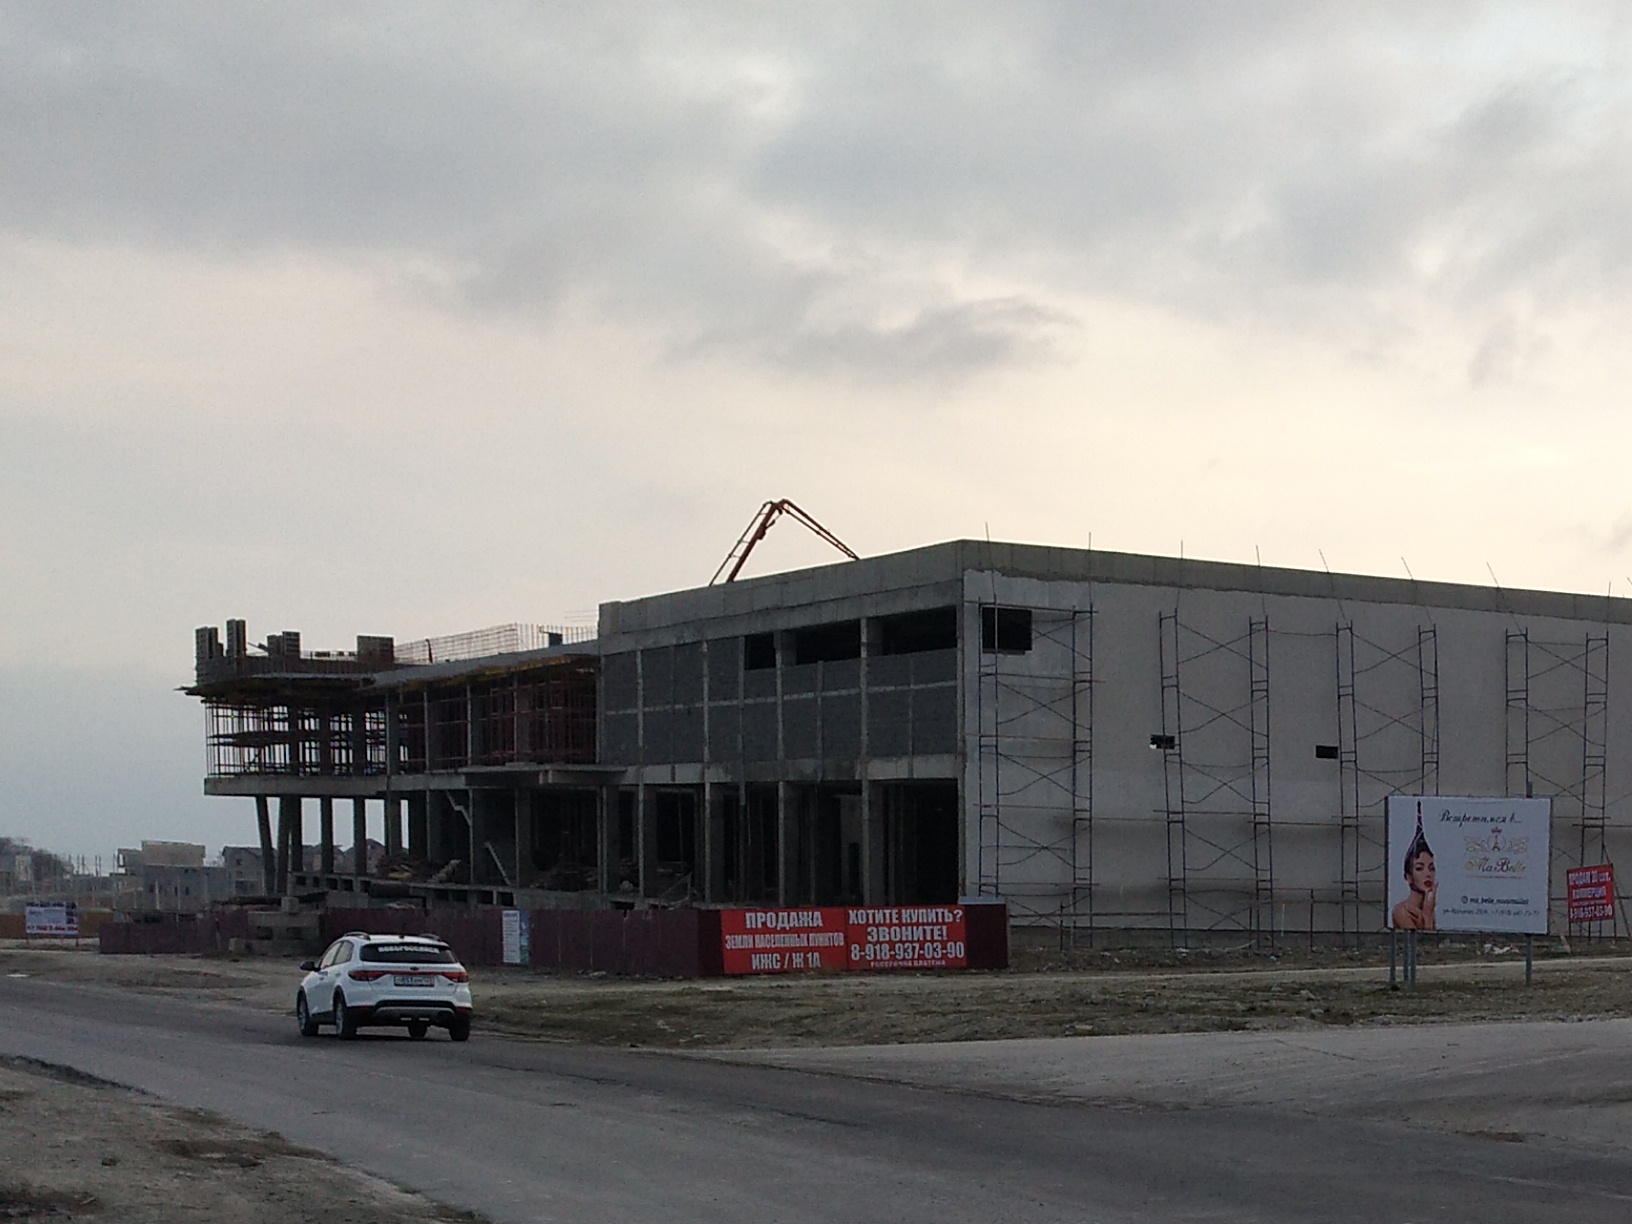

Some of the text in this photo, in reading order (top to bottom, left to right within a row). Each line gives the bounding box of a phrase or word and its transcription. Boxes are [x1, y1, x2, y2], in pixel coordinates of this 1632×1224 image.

[745, 911, 823, 930] ПРОДАЖА
[848, 908, 963, 924] ХОТИТЕ КУПИТЬ?
[725, 932, 845, 949] ЗЕМЛИ НАСЕЛЕННЫХ ПУНКТОВ
[867, 925, 948, 942] ЗВОНИТЕ!
[851, 941, 965, 961] 8-918-937-03-90
[751, 953, 780, 970] ИЖС
[792, 953, 804, 969] Ж
